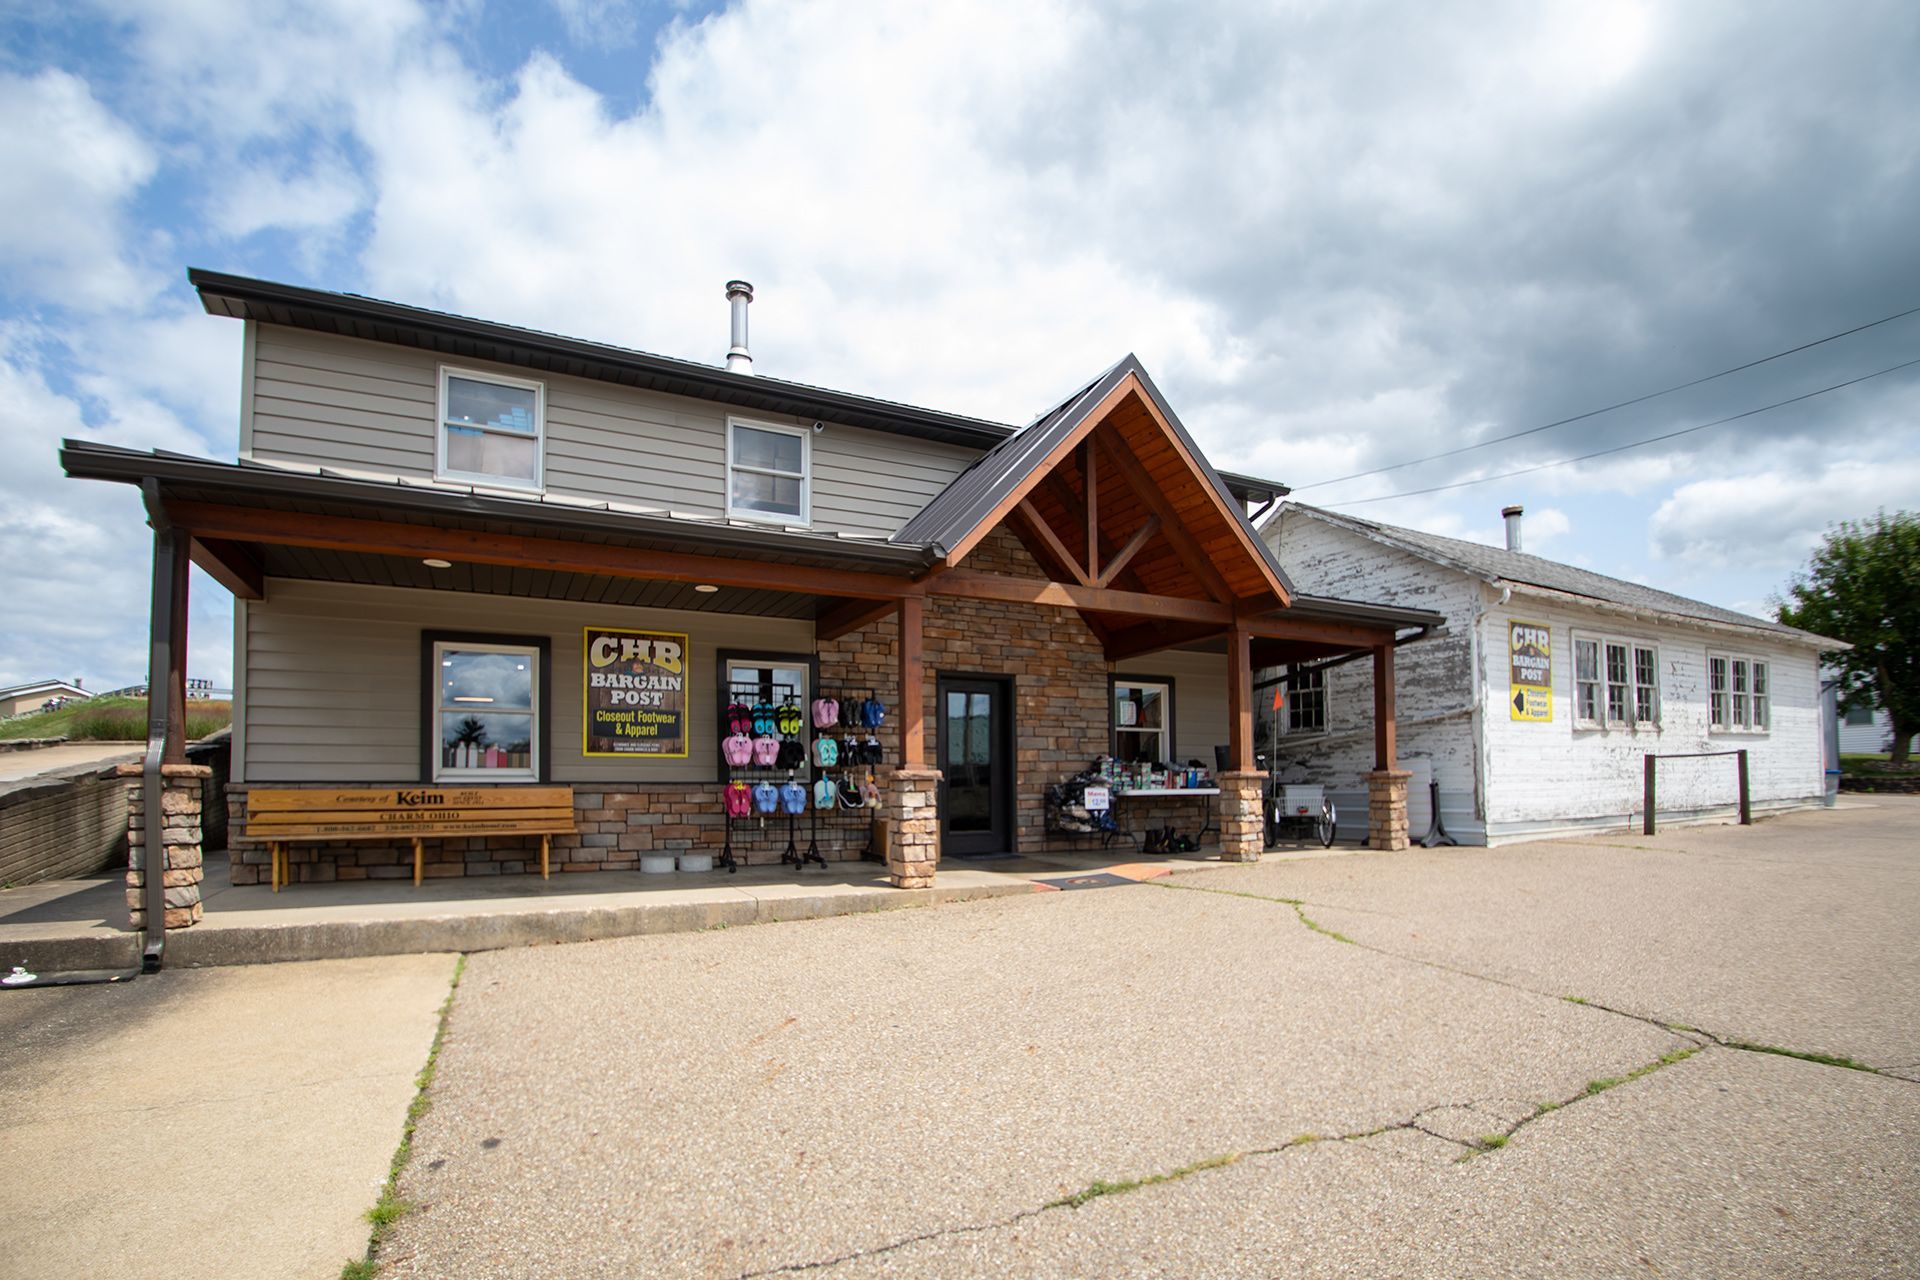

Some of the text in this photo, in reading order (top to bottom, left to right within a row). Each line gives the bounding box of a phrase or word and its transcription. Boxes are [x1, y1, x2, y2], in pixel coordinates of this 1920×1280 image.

[1512, 626, 1549, 657] CHB
[590, 636, 682, 674] CHB
[1513, 655, 1549, 669] BARGAIN
[590, 672, 682, 691] BARGAIN
[1521, 667, 1543, 681] POST
[611, 689, 663, 706] POST
[596, 710, 676, 724] Closeout Footwear
[615, 722, 658, 737] & Apparel
[396, 791, 445, 806] Keim
[380, 811, 460, 822] CHARM OHIO
